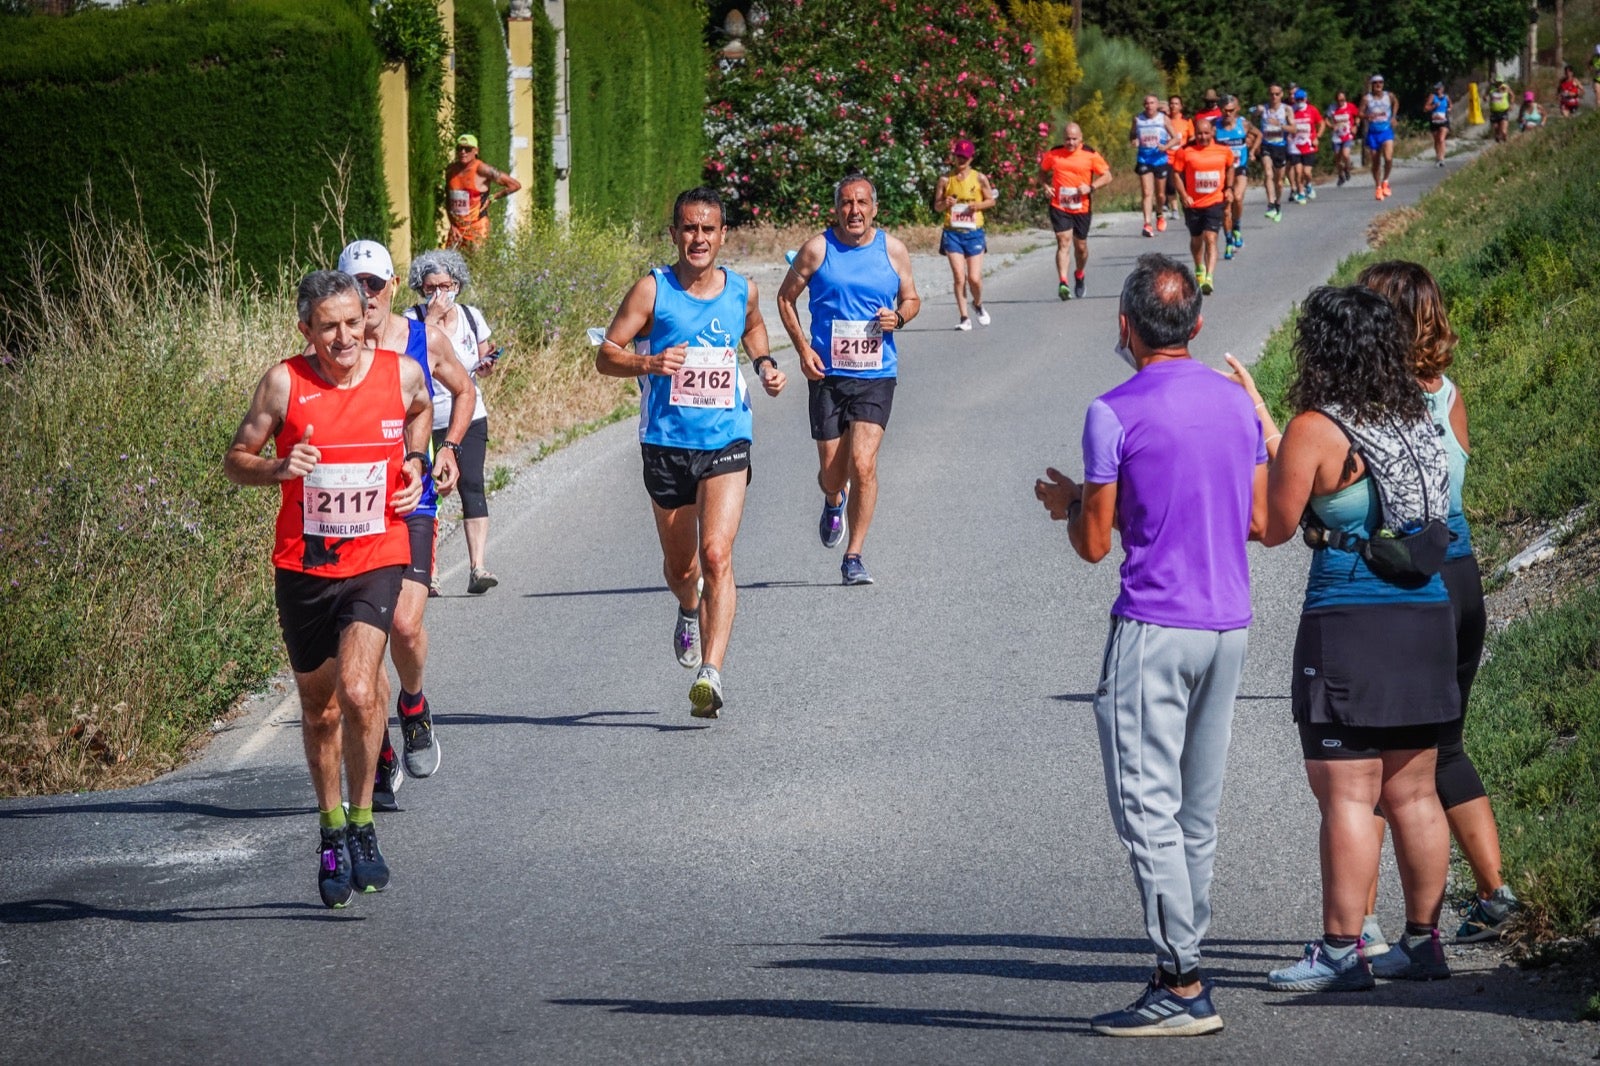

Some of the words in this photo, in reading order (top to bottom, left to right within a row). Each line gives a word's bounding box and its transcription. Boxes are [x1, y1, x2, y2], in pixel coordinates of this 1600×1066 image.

[840, 340, 878, 354] 2192
[683, 370, 731, 389] 2162
[317, 490, 378, 514] 2117
[319, 523, 347, 535] MANUEL
[350, 522, 370, 534] PABLO
